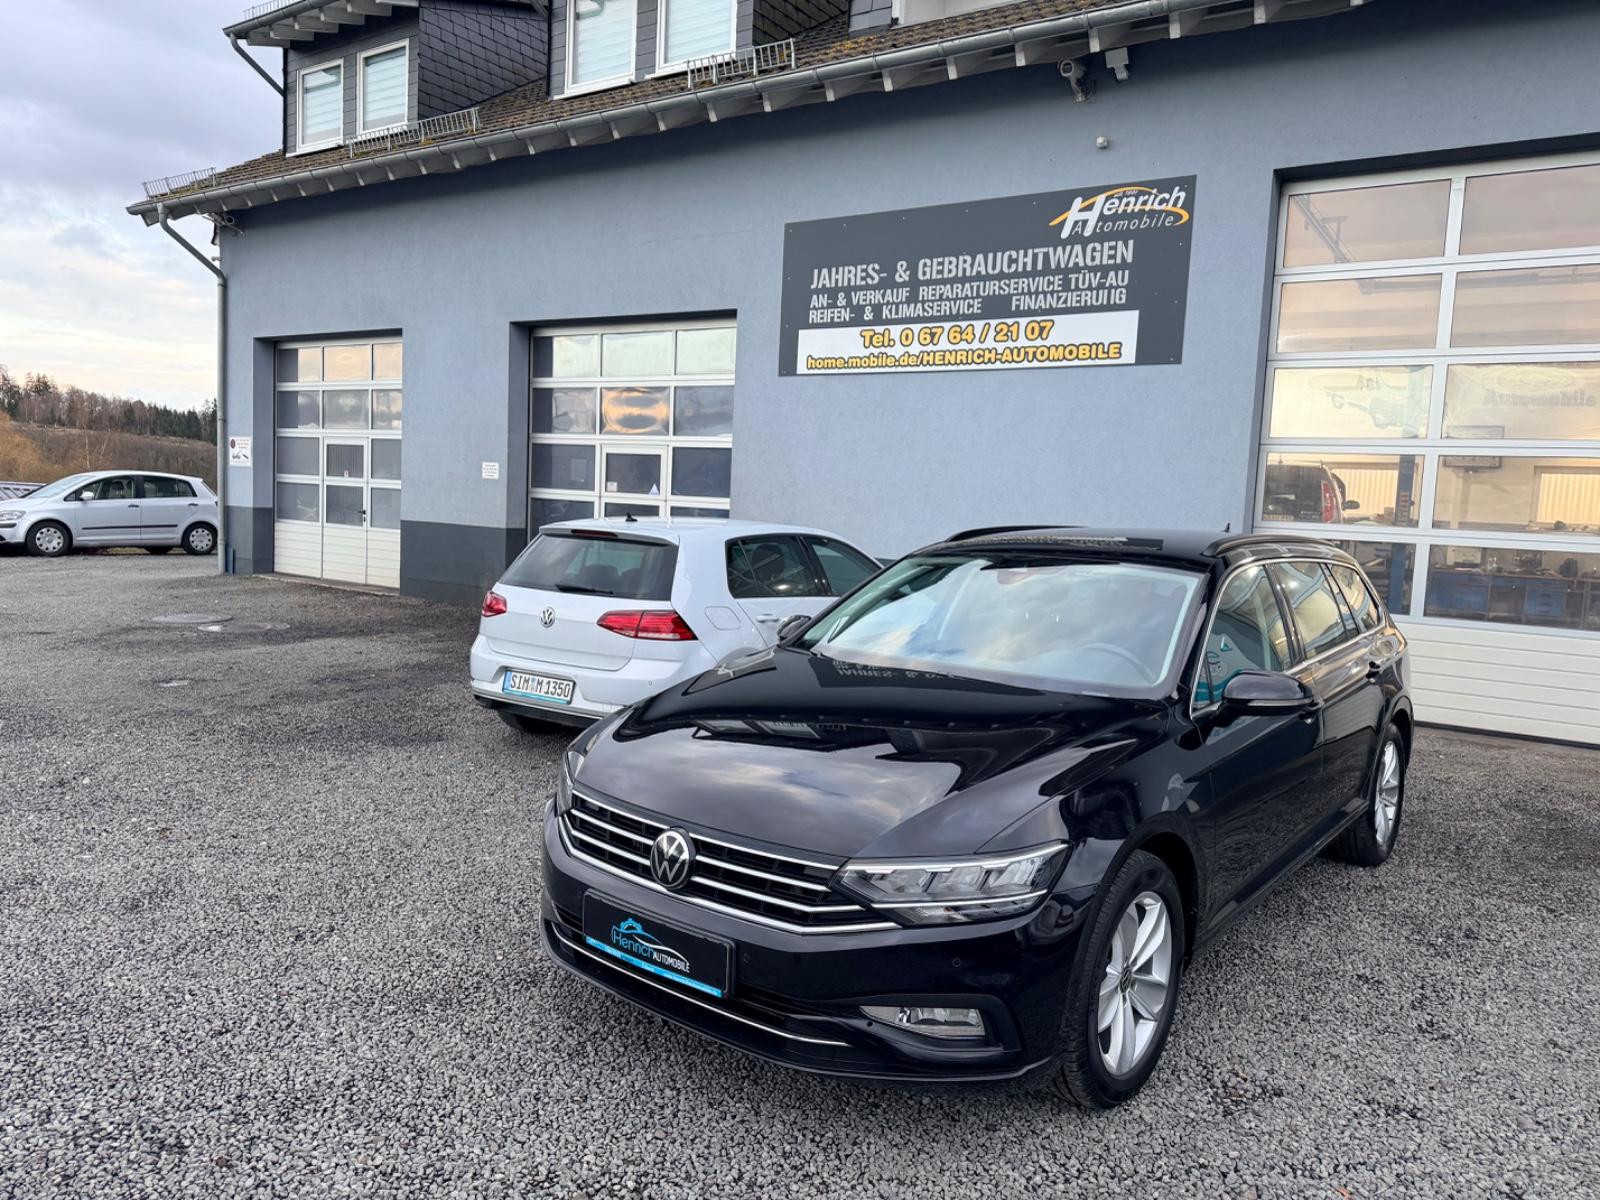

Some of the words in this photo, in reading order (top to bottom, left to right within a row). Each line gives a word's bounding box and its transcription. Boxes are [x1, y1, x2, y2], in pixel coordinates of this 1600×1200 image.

[1060, 186, 1187, 239] Henrich
[1072, 213, 1175, 236] Atomobile
[810, 263, 887, 289] JAHRES-
[895, 261, 910, 282] &
[918, 240, 1134, 281] GEBRAUCHTWAGEN
[810, 294, 833, 308] AN-
[837, 292, 847, 306] &
[851, 288, 910, 305] VERKAUF
[919, 275, 1063, 300] REPARATURSERVICE
[1069, 270, 1129, 290] TÜV-AU
[809, 307, 855, 324] REIFEN-
[863, 306, 874, 321] &
[882, 298, 982, 319] KLIMASERVICE
[860, 329, 895, 348] Tel.
[900, 327, 914, 346] 0
[918, 326, 944, 346] 67
[948, 324, 975, 345] 64
[979, 322, 990, 343] /
[994, 321, 1020, 343] 21
[1025, 319, 1054, 341] 07
[807, 342, 1122, 369] home.mobile.de/HENRICH-AUTOMOBILE
[511, 674, 530, 692] SIM
[544, 680, 571, 698] 1350
